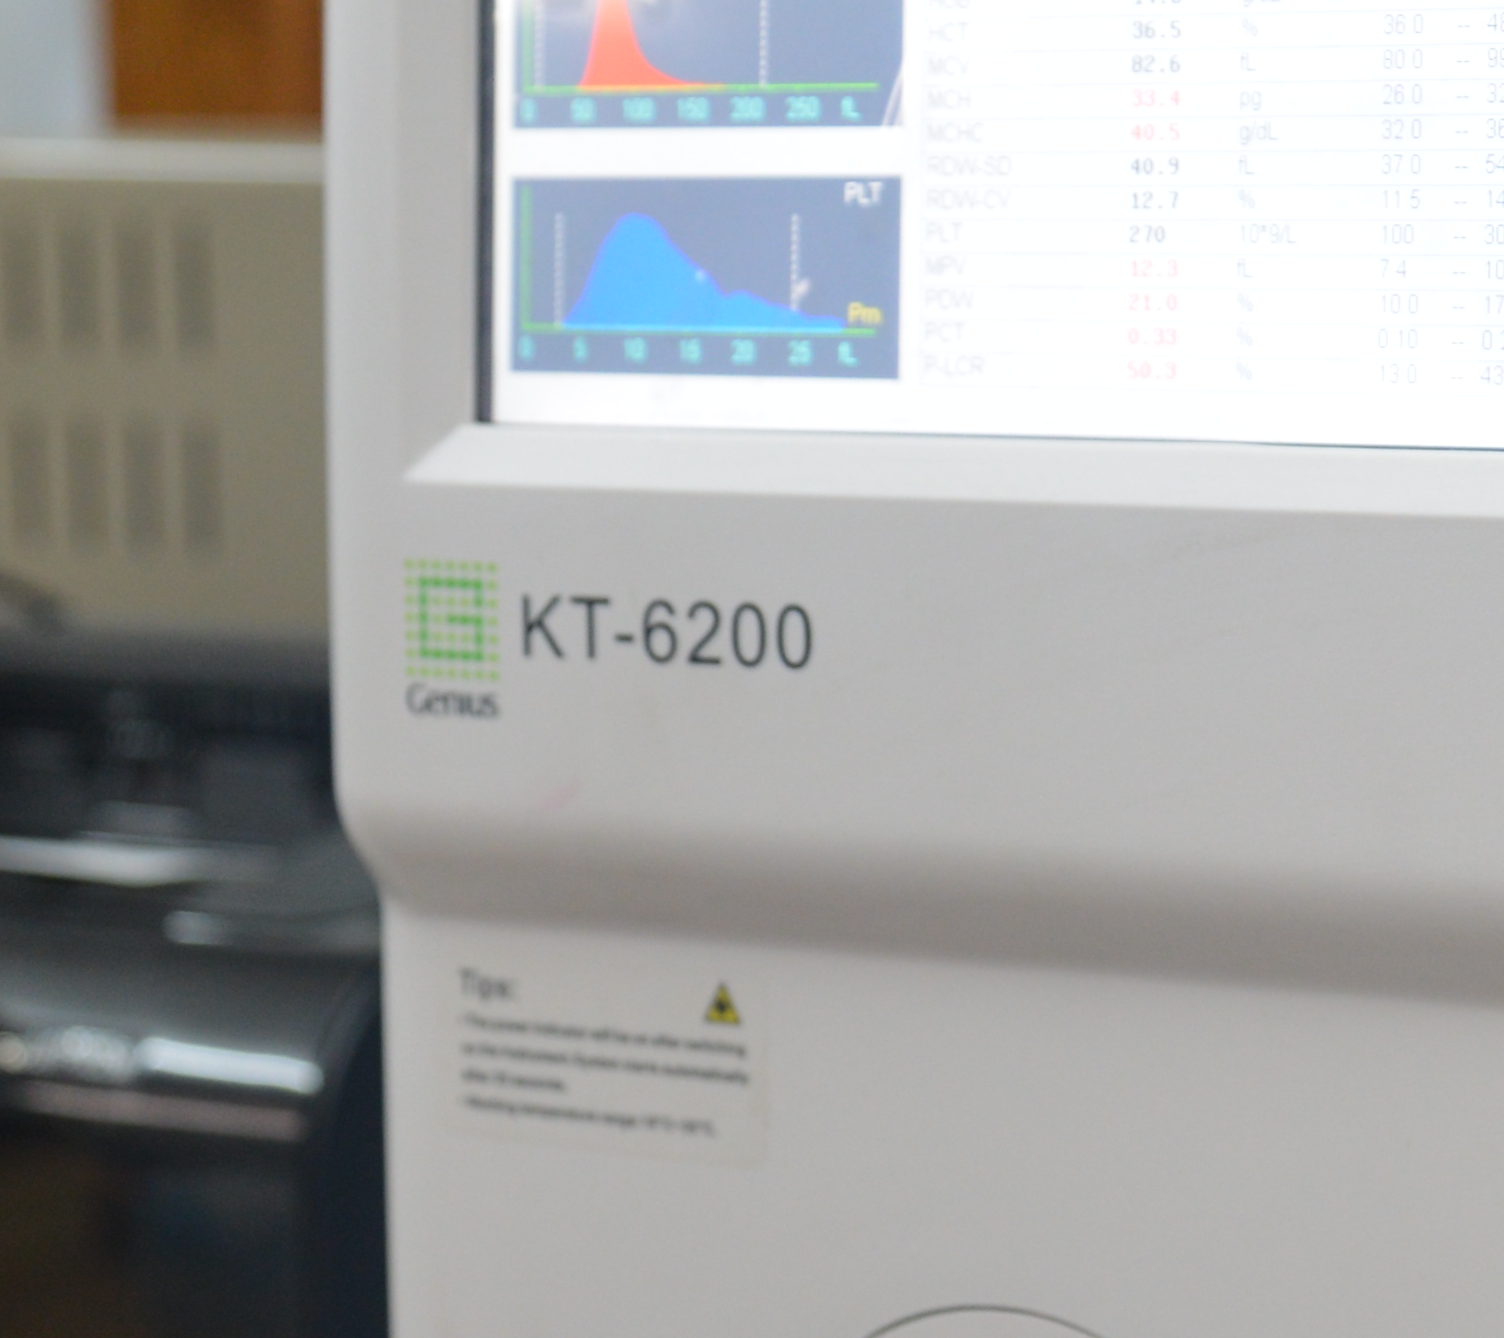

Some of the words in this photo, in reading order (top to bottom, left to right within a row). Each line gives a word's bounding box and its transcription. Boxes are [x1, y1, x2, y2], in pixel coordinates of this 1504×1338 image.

[1133, 20, 1181, 39] 36.5
[1131, 55, 1181, 73] 82.6
[928, 90, 971, 110] MCH
[1133, 89, 1180, 107] 33.4
[1131, 123, 1180, 140] 40.5
[1130, 158, 1179, 175] 40.9
[844, 182, 883, 203] PLT
[1132, 191, 1179, 210] 12.7
[926, 222, 961, 243] PLT
[1129, 225, 1166, 243] 270
[1132, 260, 1178, 277] 12.3
[1129, 293, 1178, 311] 21.0
[925, 322, 965, 344] PCT
[1128, 328, 1177, 345] 0.33
[1127, 361, 1177, 379] 50.3
[521, 594, 813, 671] KT-6200
